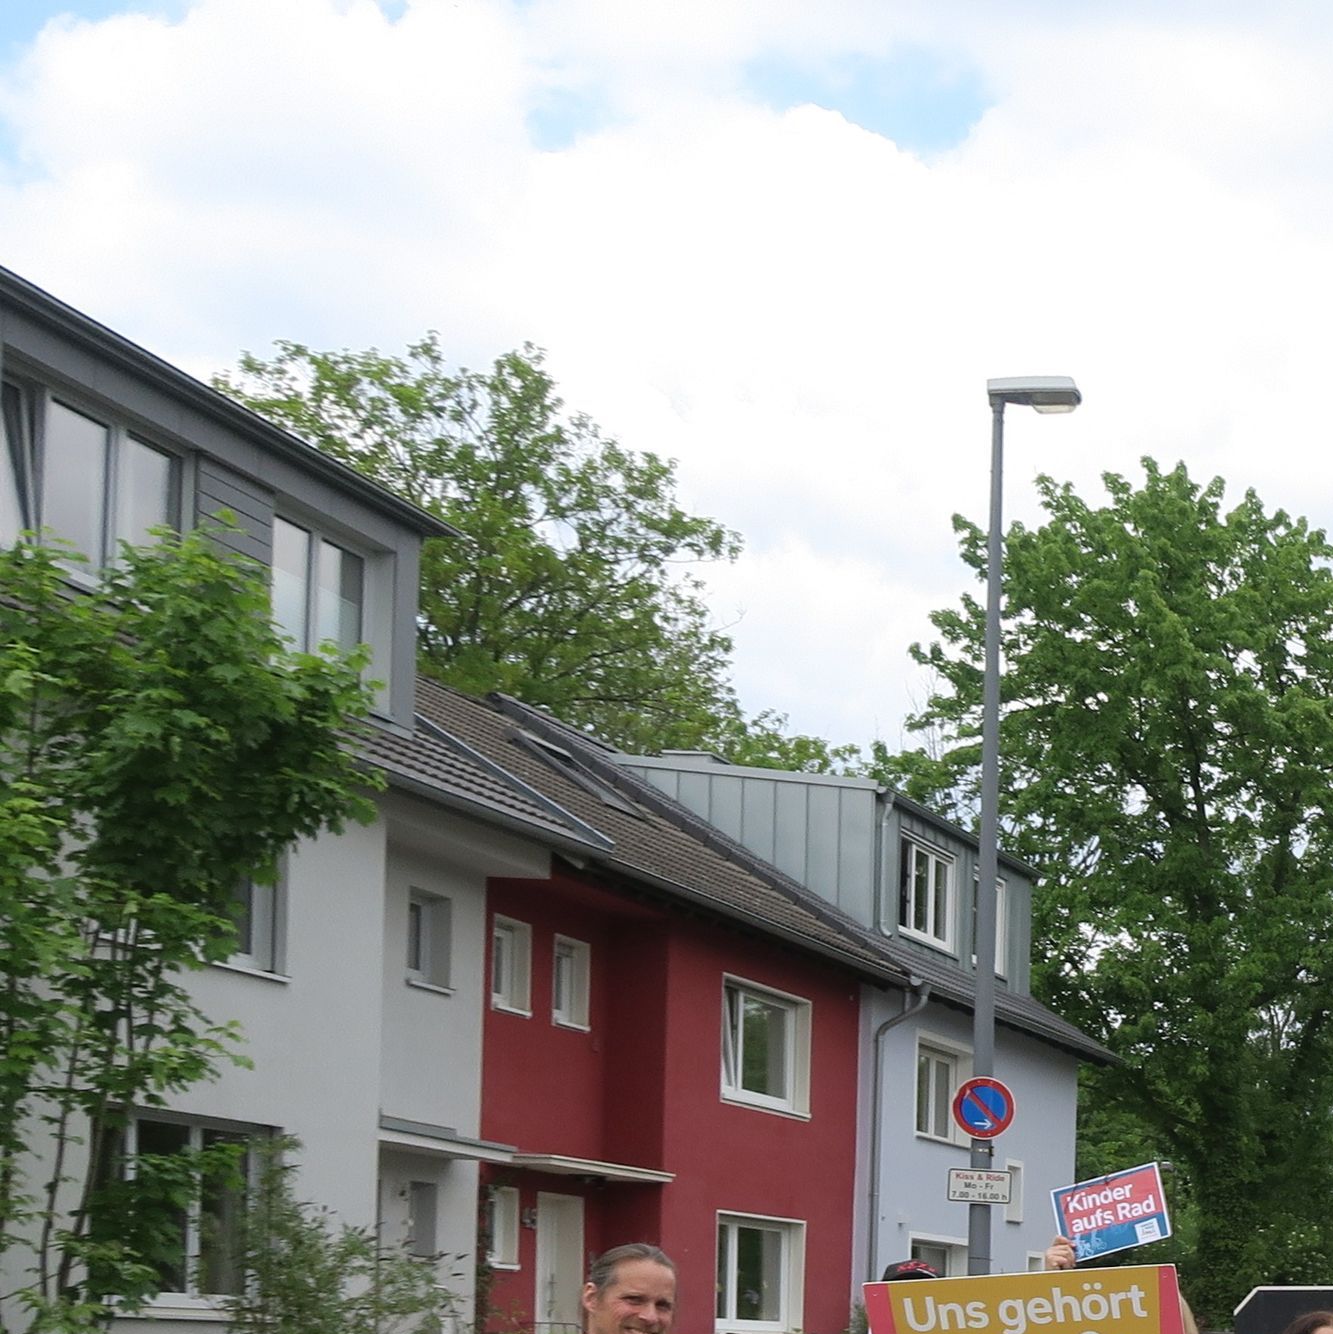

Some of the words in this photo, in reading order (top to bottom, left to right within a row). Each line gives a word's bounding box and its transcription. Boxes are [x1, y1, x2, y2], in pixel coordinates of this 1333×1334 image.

[955, 1172, 974, 1180] Kiss
[985, 1182, 994, 1190] Fr
[1066, 1183, 1133, 1214] Kinder
[1071, 1212, 1115, 1234] aufs
[1116, 1195, 1156, 1220] Rad
[903, 1296, 990, 1333] Uns
